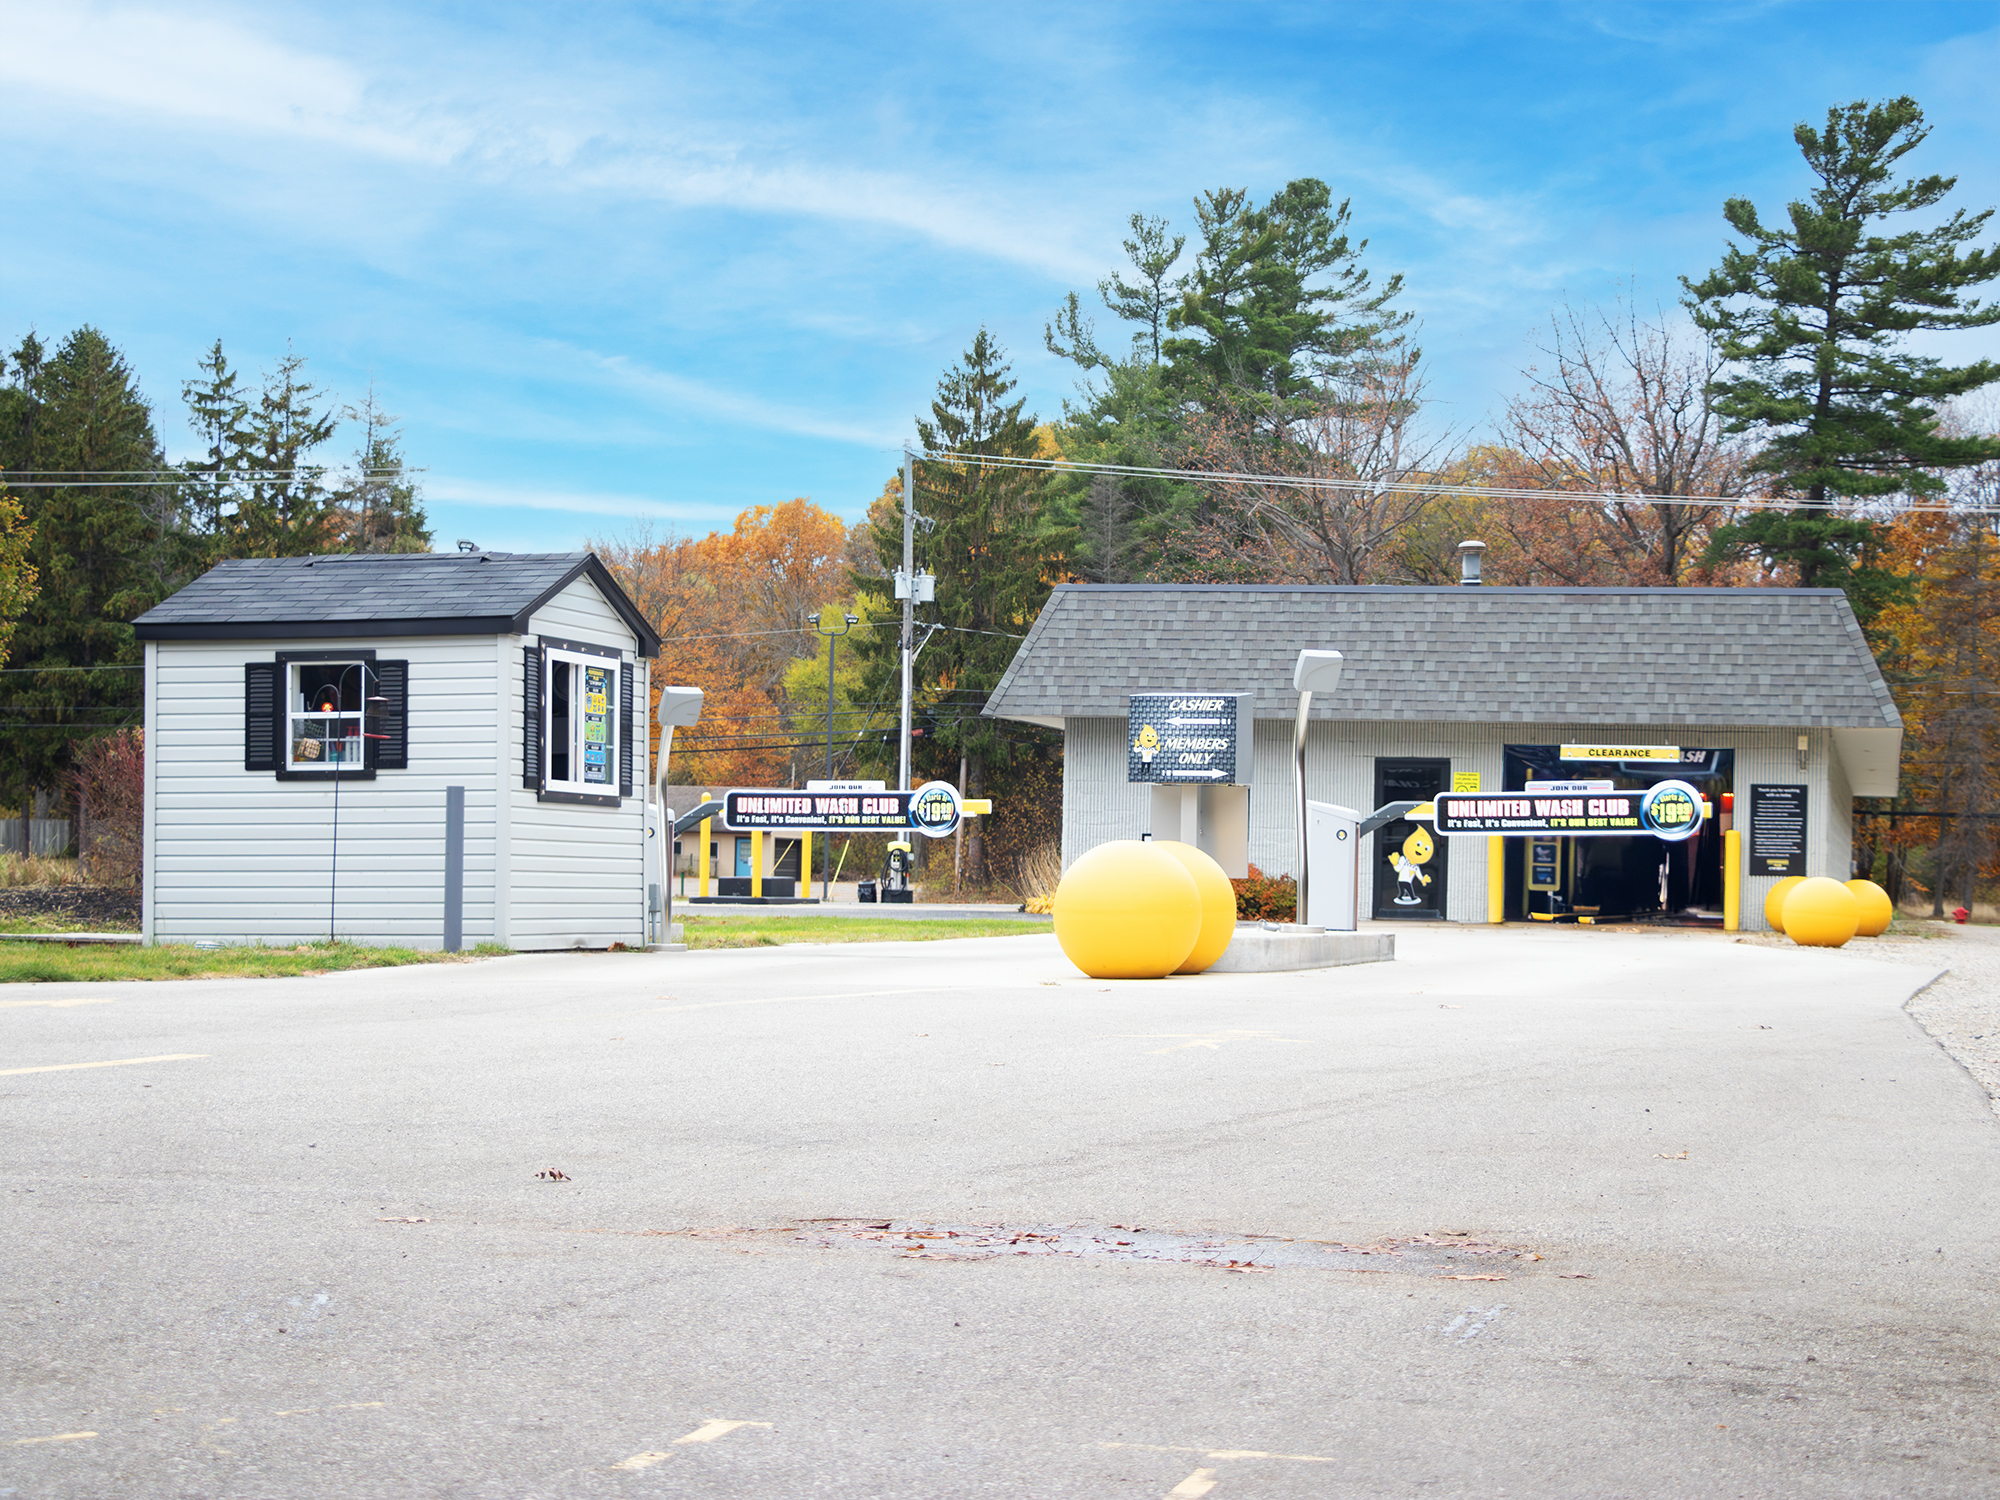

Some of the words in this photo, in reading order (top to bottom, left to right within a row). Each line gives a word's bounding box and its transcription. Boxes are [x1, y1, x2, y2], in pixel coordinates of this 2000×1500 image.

[1168, 699, 1225, 711] CASHIER
[1163, 738, 1229, 750] MEMBERS
[1178, 753, 1214, 765] ONLY
[1588, 749, 1651, 757] CLEARANCE
[736, 797, 812, 814] UNLIMITED
[814, 797, 859, 814] WASH
[862, 798, 900, 814] CLUB
[1447, 800, 1531, 817] UNLIMITED
[1534, 799, 1584, 817] WASH
[1587, 799, 1630, 816] CLUB
[736, 815, 750, 823] It's
[751, 815, 769, 824] Fast,
[770, 815, 785, 824] It's
[785, 816, 828, 825] Convenient,
[829, 816, 843, 824] IT'S
[844, 816, 861, 824] OUR
[861, 816, 879, 824] BEST
[881, 816, 907, 824] VALUE!
[1447, 819, 1462, 828] It's
[1463, 819, 1484, 828] Fast,
[1485, 819, 1500, 828] It's
[1501, 818, 1549, 828] Convenient,
[1550, 818, 1567, 827] IT'S
[1568, 818, 1586, 827] OUR
[1587, 818, 1608, 827] BEST
[1610, 818, 1638, 827] VALUE!
